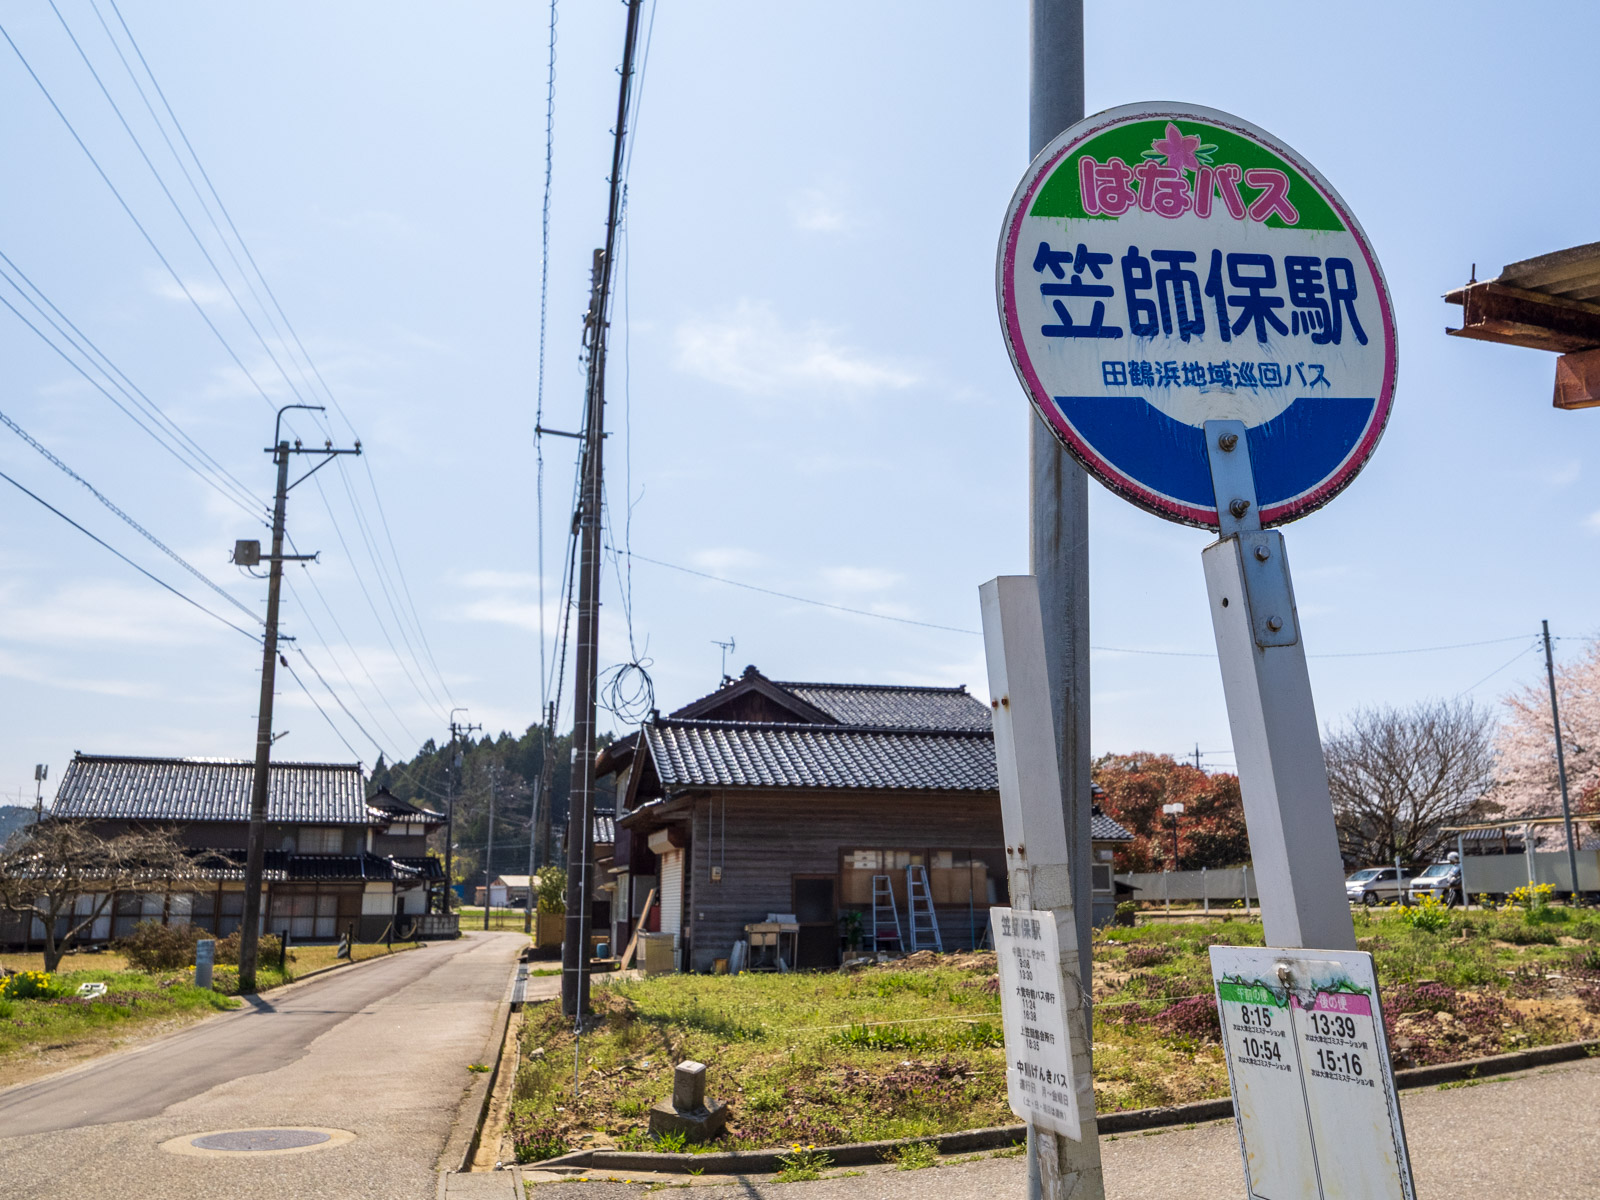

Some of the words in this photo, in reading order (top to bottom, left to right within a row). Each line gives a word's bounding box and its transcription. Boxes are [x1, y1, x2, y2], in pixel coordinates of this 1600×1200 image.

[1078, 155, 1299, 226] はなバス
[1033, 241, 1369, 346] 笠師保駅
[1102, 360, 1331, 388] 田鶴浜地域巡回バス
[1241, 1005, 1271, 1027] 8:15
[1315, 994, 1348, 1011] 後の便
[1311, 1013, 1355, 1039] 13:39
[1243, 1037, 1281, 1062] 10:54
[1317, 1048, 1362, 1076] 15:16
